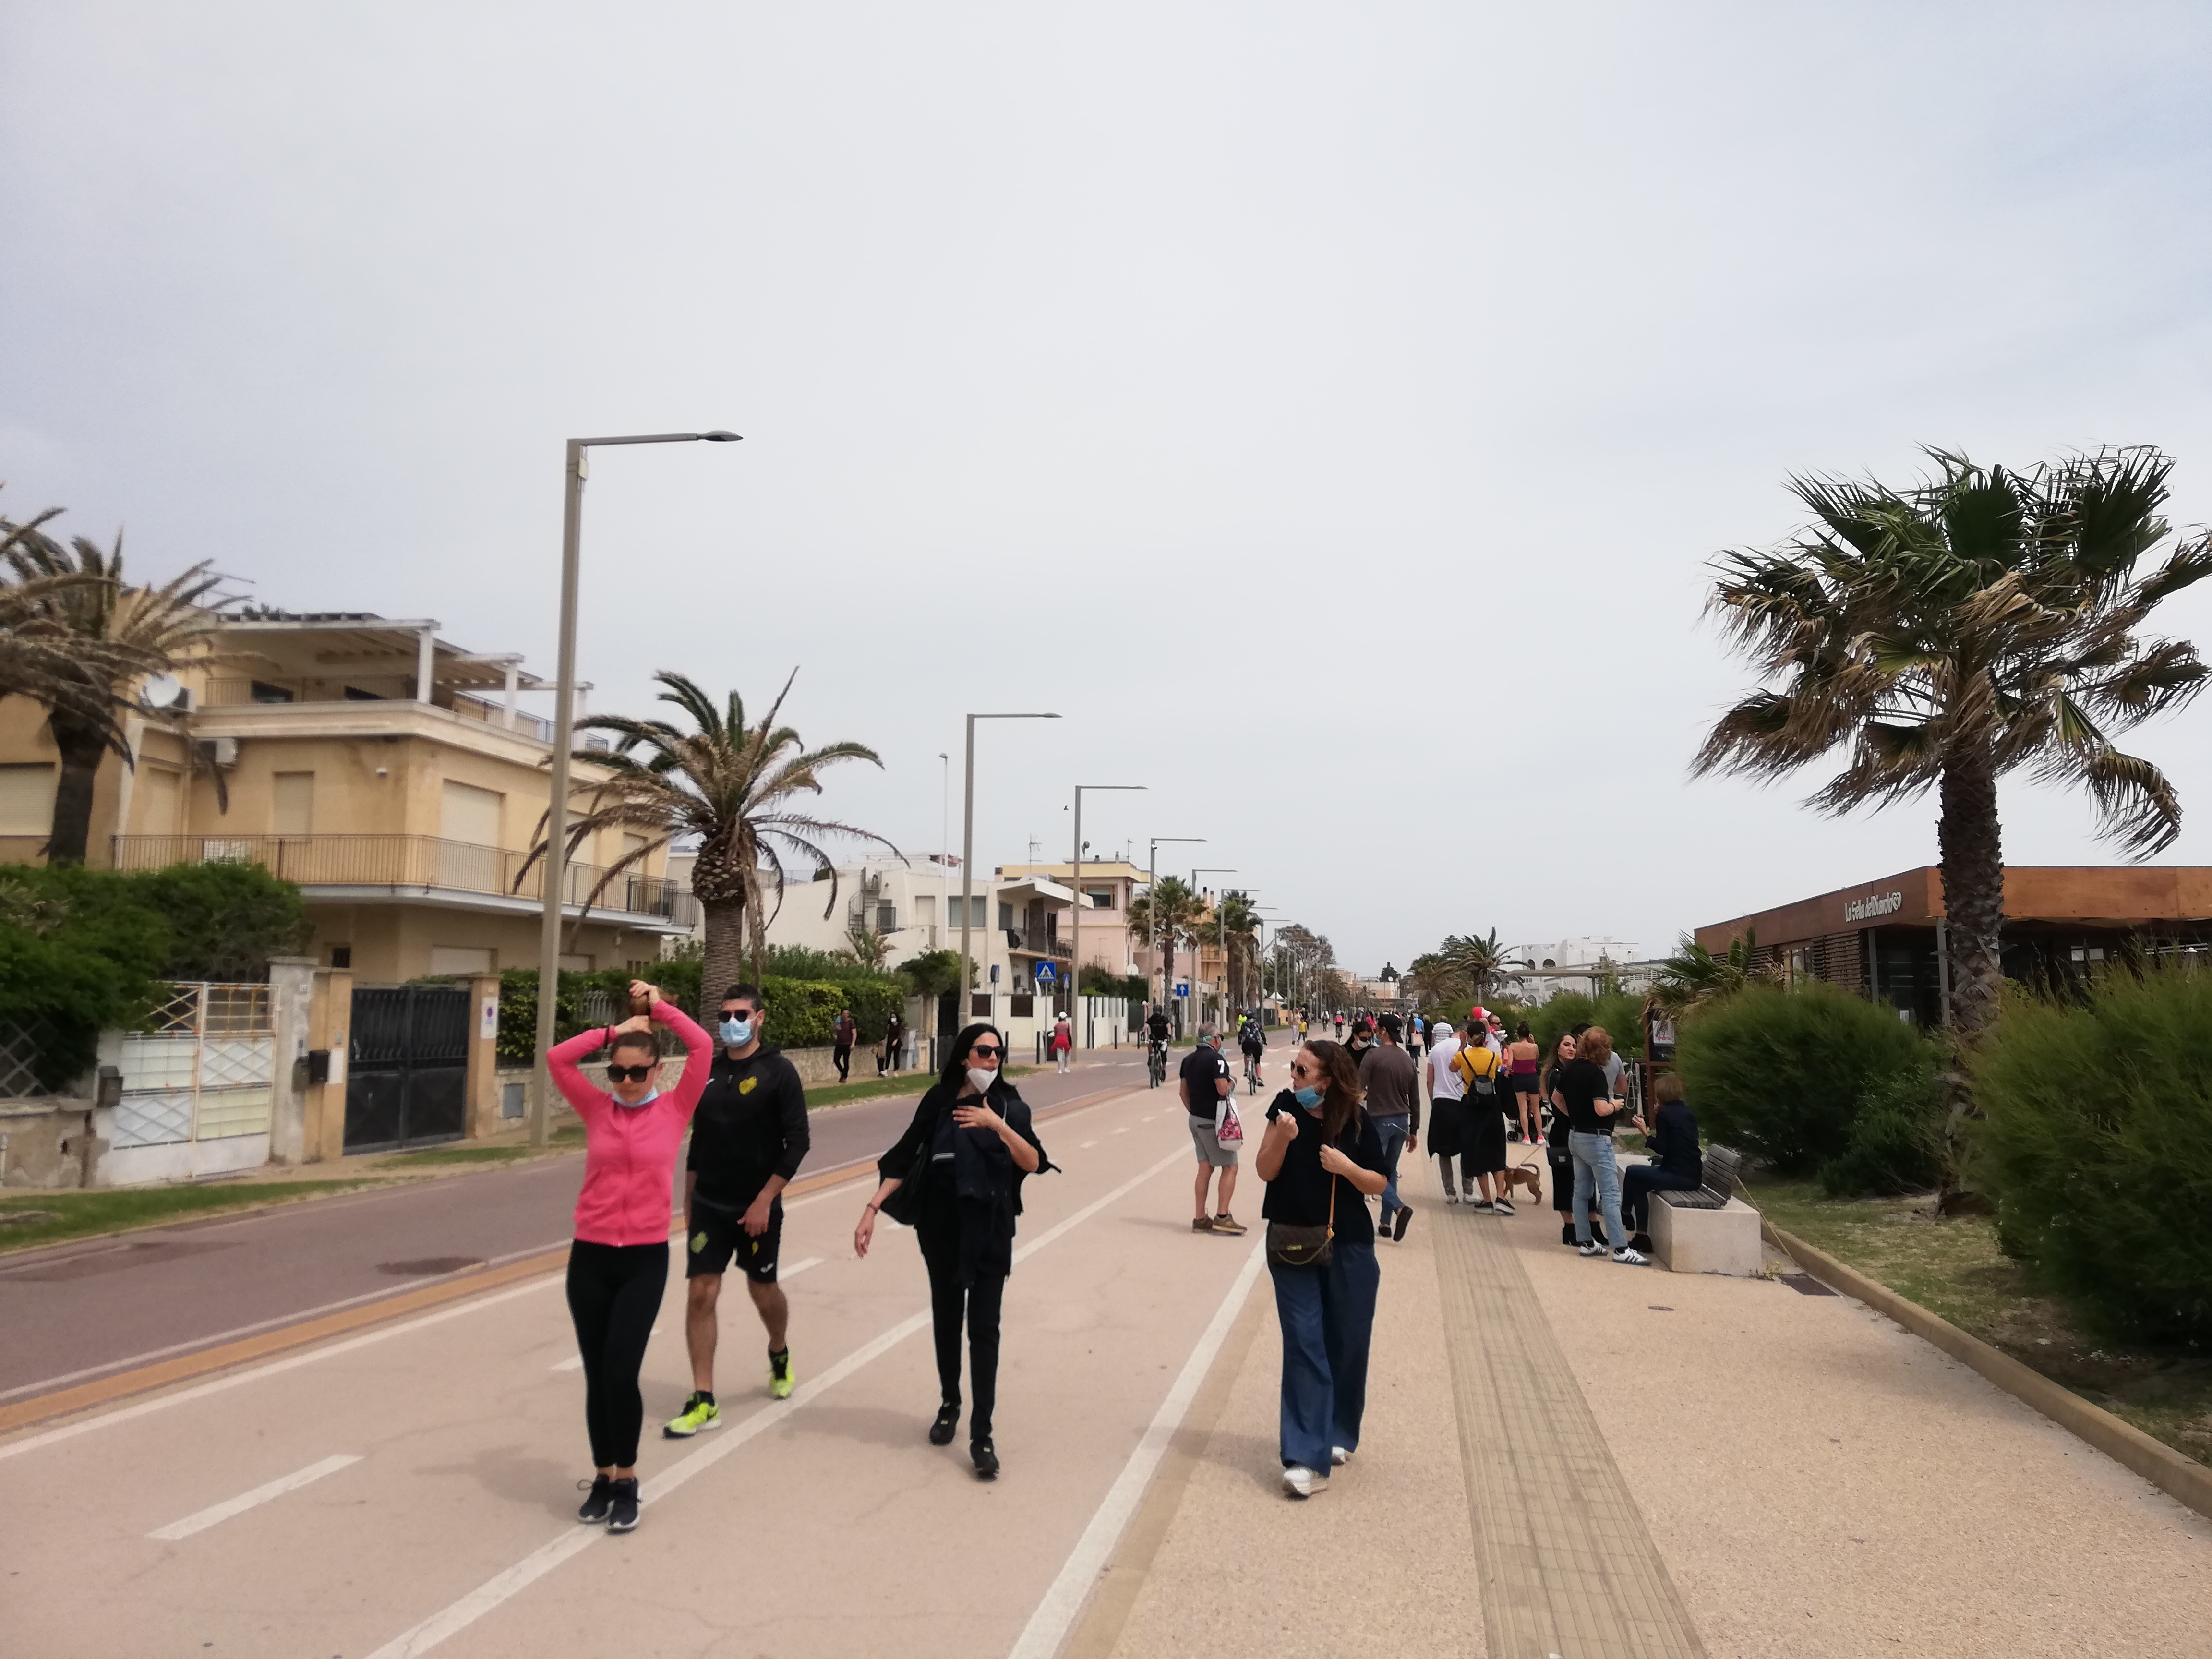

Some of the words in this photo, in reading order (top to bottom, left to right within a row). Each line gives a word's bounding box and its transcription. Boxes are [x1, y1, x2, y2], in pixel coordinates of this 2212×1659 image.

[1845, 903, 1852, 922] La
[1852, 900, 1865, 921] Sella
[1217, 1060, 1225, 1074] 7
